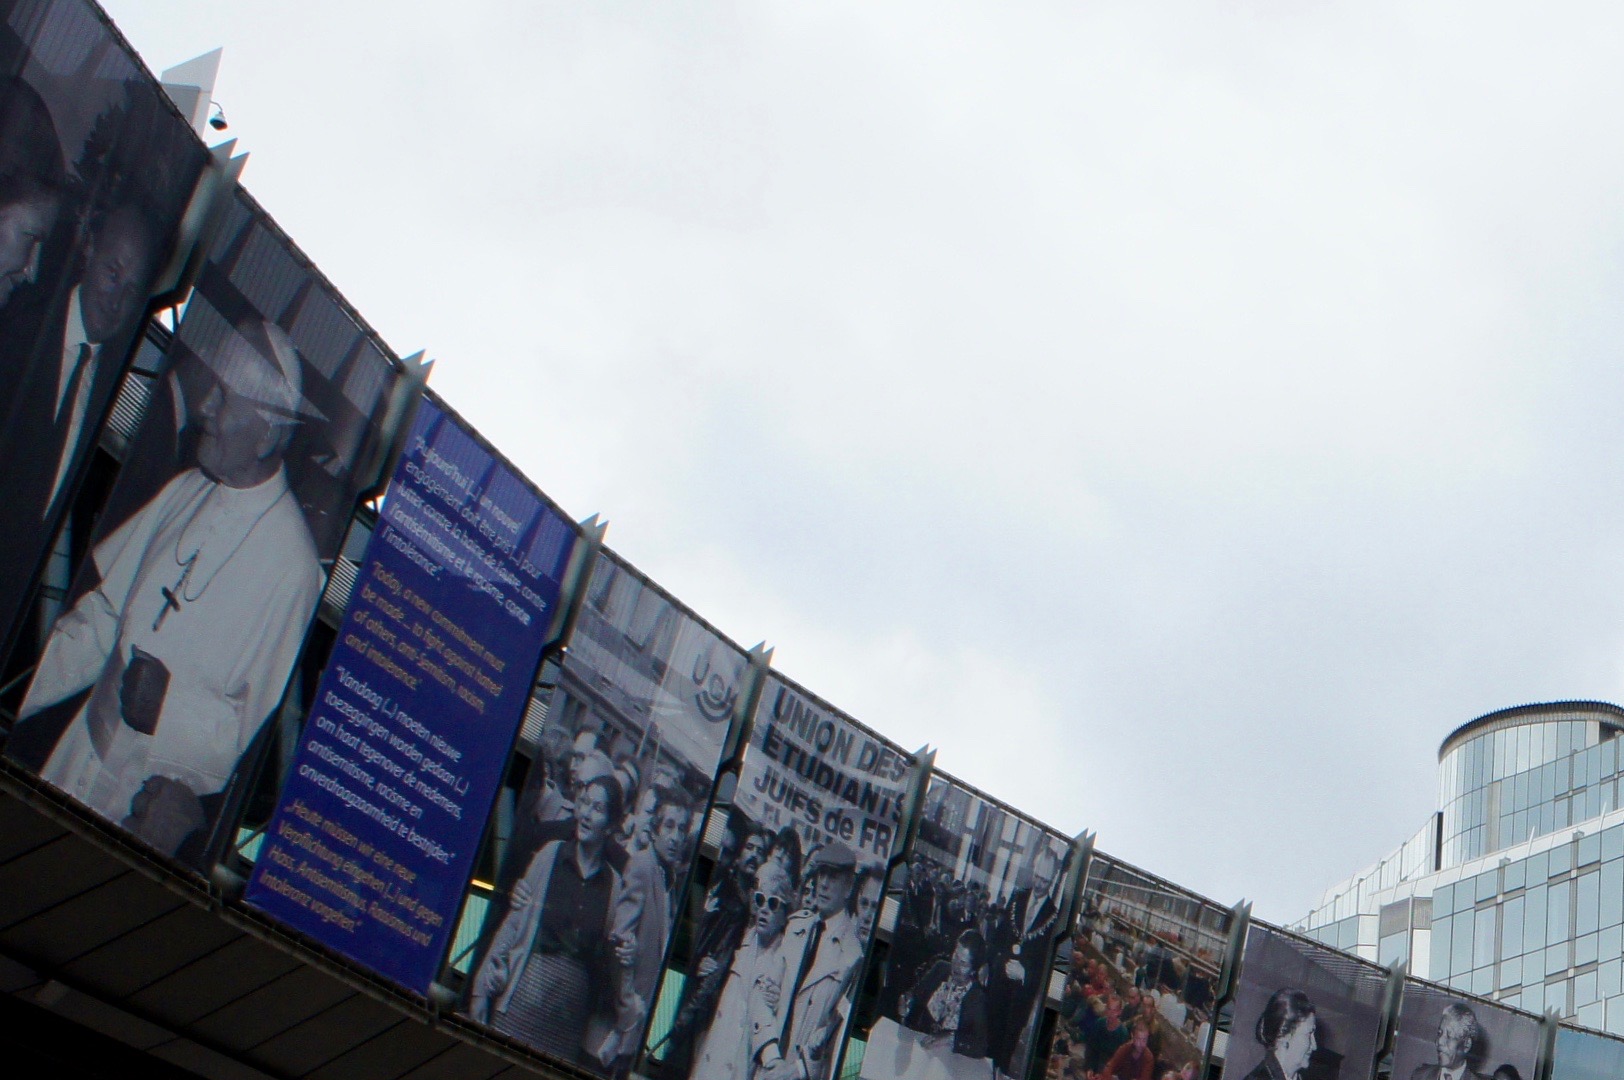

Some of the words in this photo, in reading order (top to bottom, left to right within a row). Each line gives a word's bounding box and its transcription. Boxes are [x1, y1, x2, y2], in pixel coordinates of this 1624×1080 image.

[405, 461, 462, 511] engagement
[461, 506, 480, 526] doit
[478, 518, 495, 541] être
[520, 559, 541, 578] pour
[480, 496, 492, 510] un
[423, 505, 451, 532] contre
[451, 522, 461, 539] la
[460, 530, 484, 560] haine
[483, 553, 495, 569] de
[521, 586, 546, 611] contre
[454, 557, 465, 570] et
[464, 561, 474, 577] le
[505, 599, 530, 625] contre
[353, 610, 369, 624] of
[361, 584, 376, 602] be
[376, 597, 404, 622] made
[412, 622, 423, 637] to
[423, 628, 445, 653] fight
[443, 648, 475, 676] against
[403, 588, 412, 600] a
[411, 594, 431, 614] new
[345, 634, 368, 653] and
[316, 716, 335, 734] om
[335, 724, 360, 749] haat
[359, 742, 404, 777] tegenover
[403, 771, 416, 787] de
[325, 691, 388, 738] toezeggingen
[389, 734, 422, 762] worden
[421, 758, 455, 785] gedaan
[396, 711, 430, 740] moeten
[430, 735, 461, 762] nieuwe
[773, 686, 855, 765] UNION
[856, 741, 906, 783] DES
[300, 765, 398, 830] onverdraagzaamheid
[397, 823, 408, 837] te
[376, 782, 410, 811] racisme
[409, 805, 422, 818] en
[754, 765, 824, 825] JUIFS
[824, 808, 854, 841] de
[342, 862, 384, 891] eingehen
[397, 894, 418, 911] und
[415, 905, 442, 926] gegen
[358, 842, 374, 856] wir
[373, 851, 393, 870] eine
[393, 863, 416, 883] neue
[412, 930, 432, 946] und
